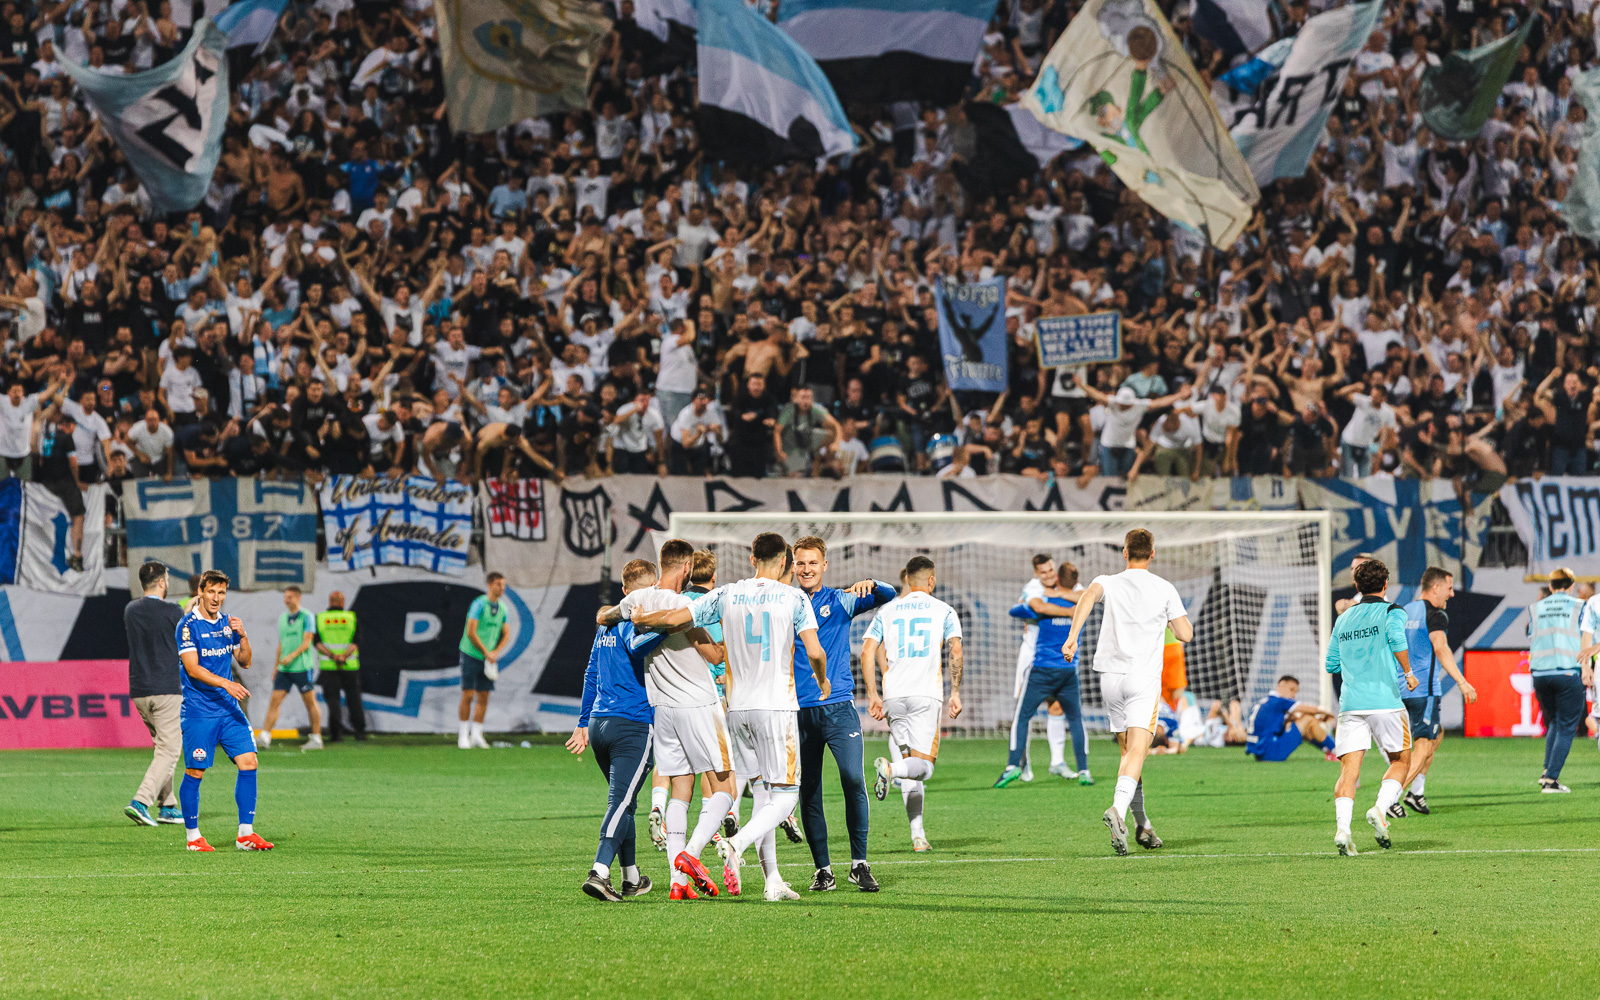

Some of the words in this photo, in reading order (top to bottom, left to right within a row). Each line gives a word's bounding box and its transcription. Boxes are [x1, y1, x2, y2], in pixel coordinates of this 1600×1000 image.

[179, 514, 284, 544] 1987
[745, 611, 770, 662] 4
[892, 617, 932, 658] 15
[1338, 630, 1353, 643] HNK
[1353, 625, 1380, 640] RIJEKA
[201, 647, 227, 658] Belupo
